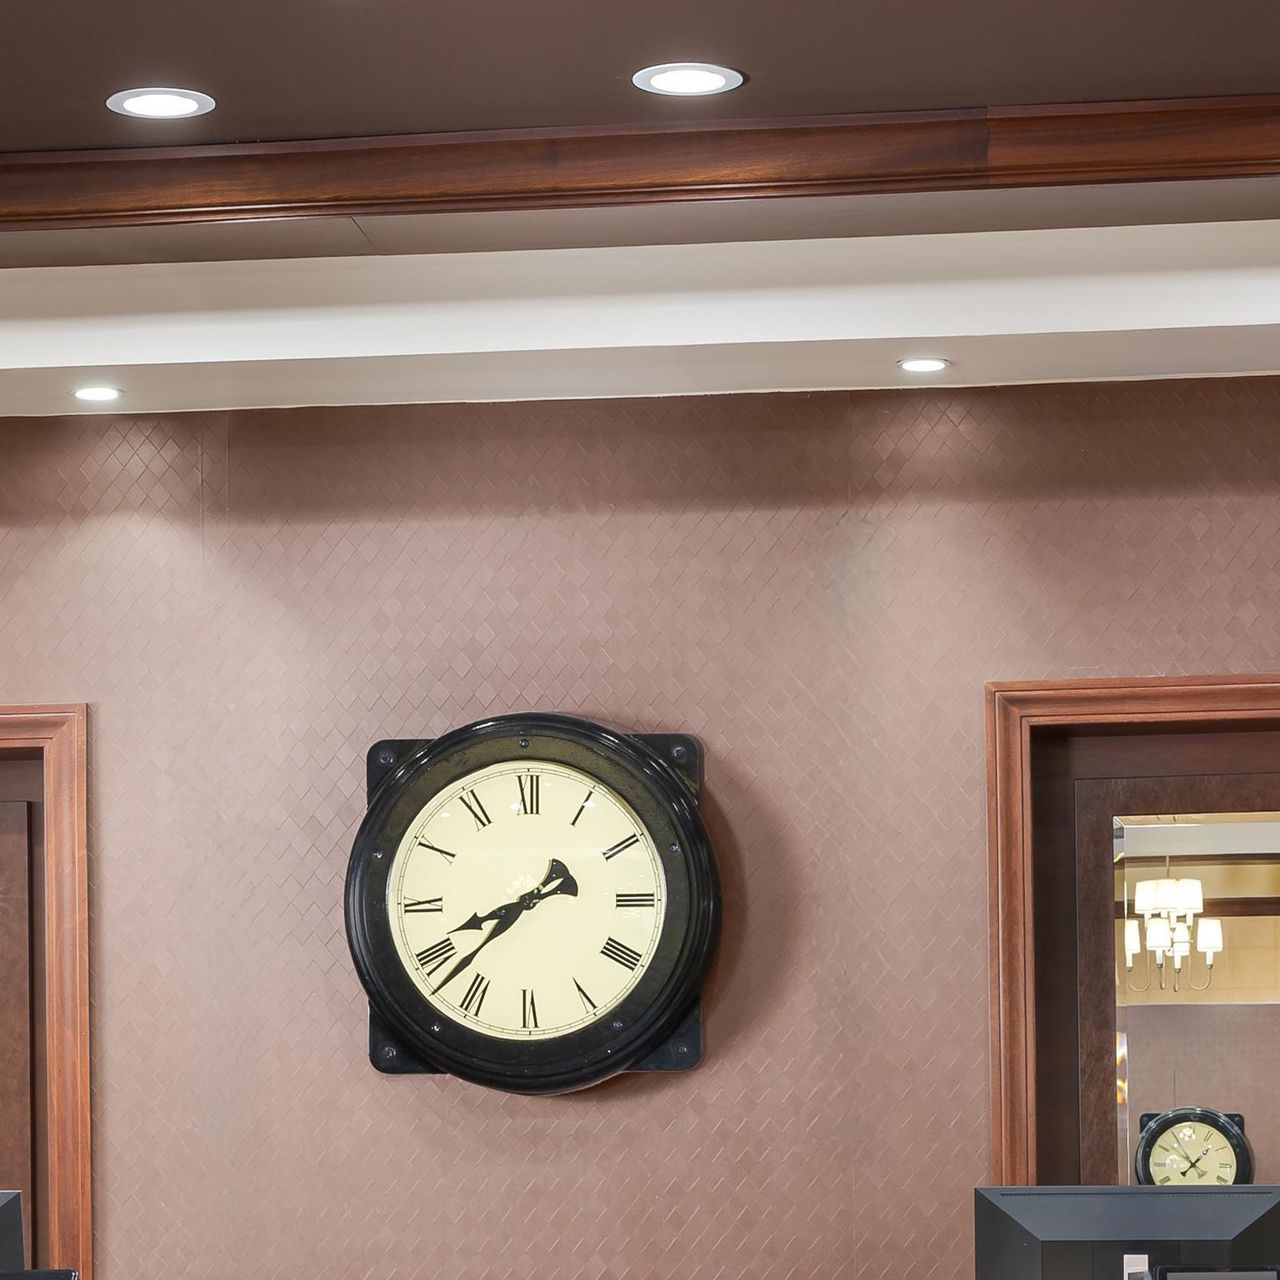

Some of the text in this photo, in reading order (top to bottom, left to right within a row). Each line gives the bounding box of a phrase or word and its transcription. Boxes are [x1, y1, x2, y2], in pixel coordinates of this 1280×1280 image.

[458, 789, 492, 831] XI
[517, 775, 540, 815] XII
[417, 836, 456, 864] X
[602, 833, 640, 861] II
[404, 896, 443, 914] IX
[616, 893, 654, 908] III
[414, 937, 458, 977] VIII
[600, 936, 642, 971] IIII
[459, 972, 490, 1018] VII
[521, 989, 540, 1028] VI
[573, 977, 598, 1014] V
